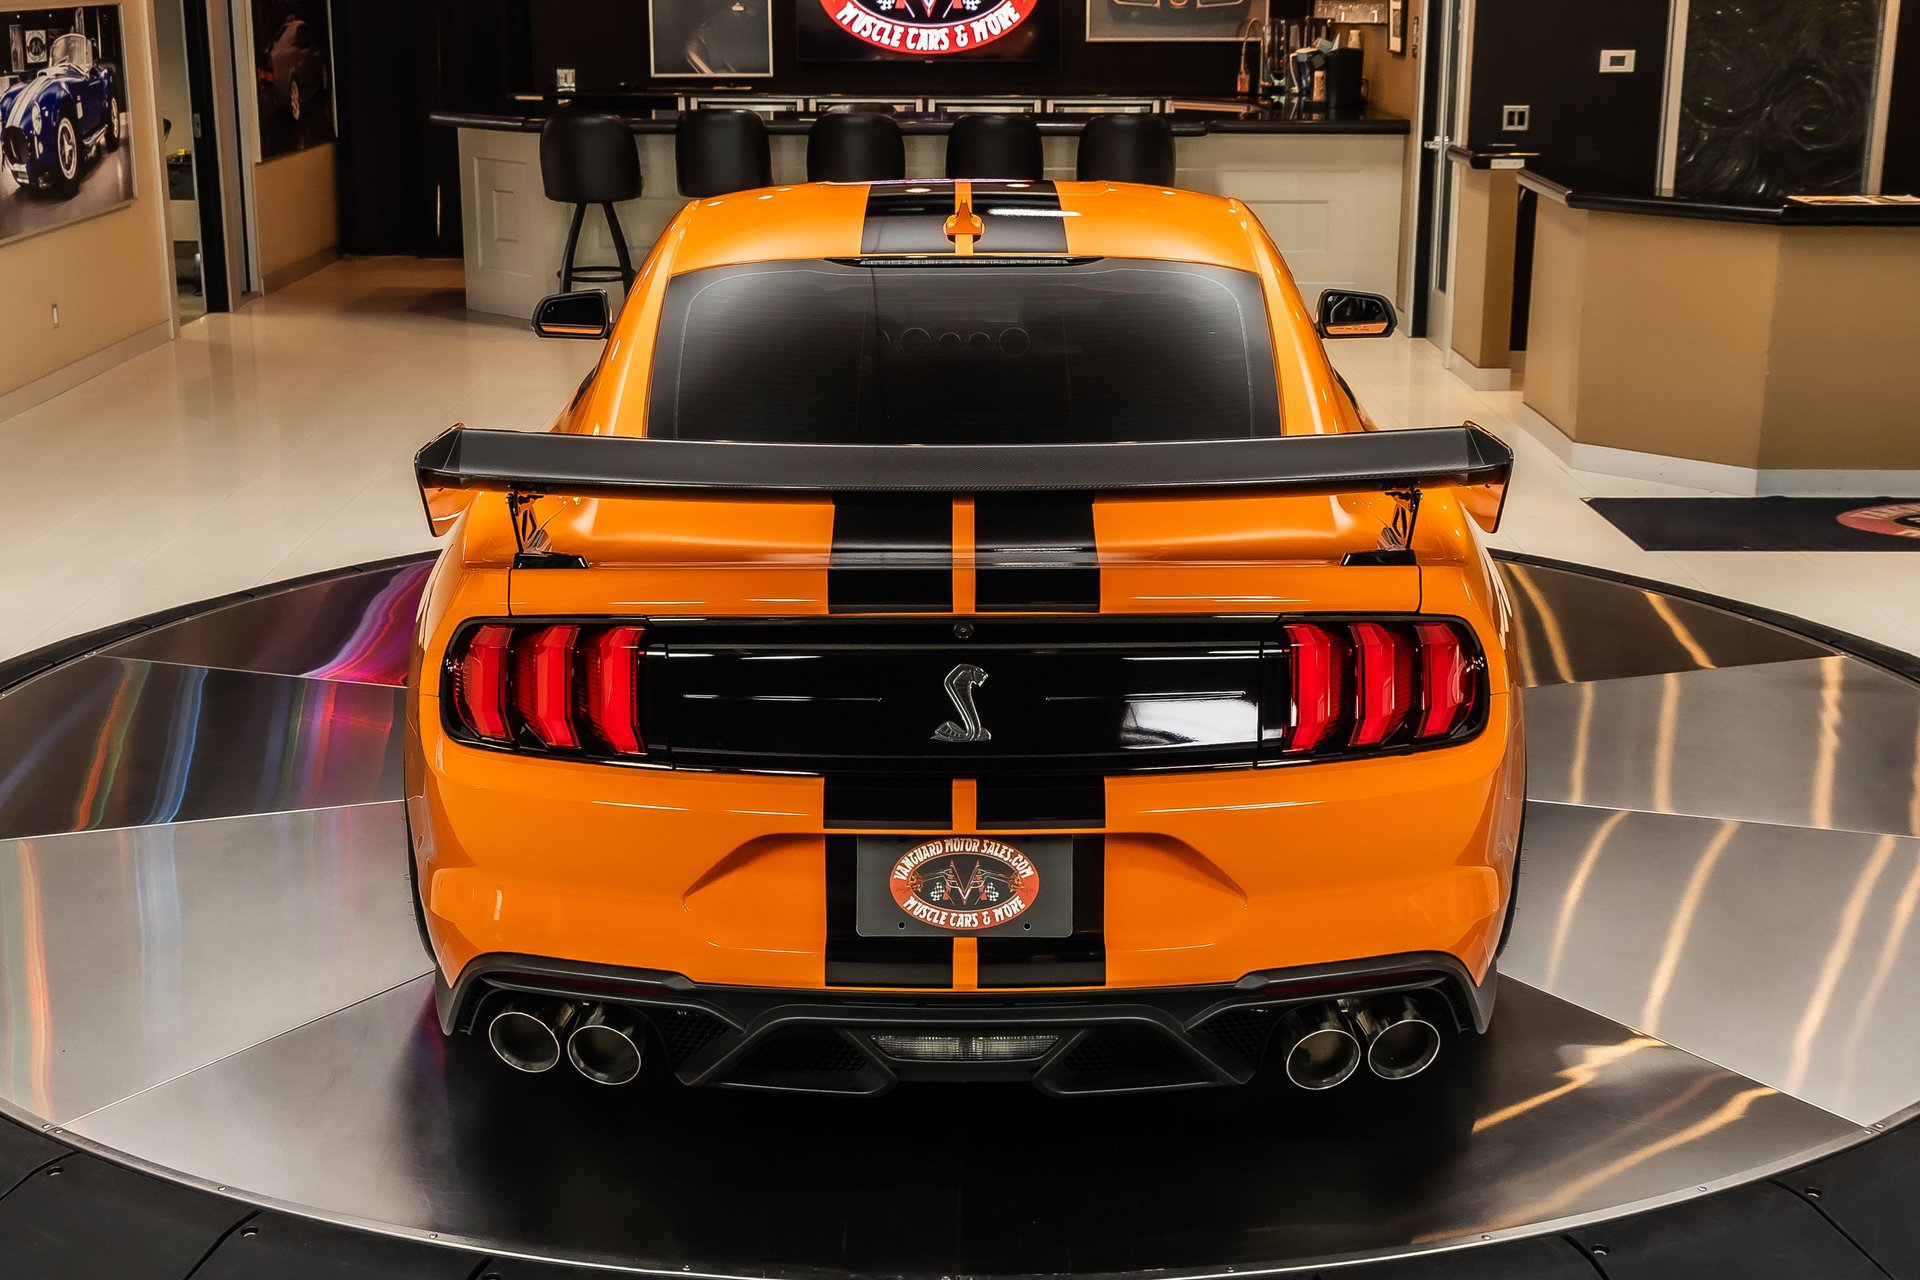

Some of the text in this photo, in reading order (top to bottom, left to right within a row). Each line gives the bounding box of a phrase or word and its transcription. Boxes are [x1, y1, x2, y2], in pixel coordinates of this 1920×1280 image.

[835, 1, 1022, 51] MUSCLE CARS & MORE
[893, 838, 1035, 880] VANGUARD MOTOR SALES.COM
[903, 895, 1026, 928] MUSCLE CARS & MORE
